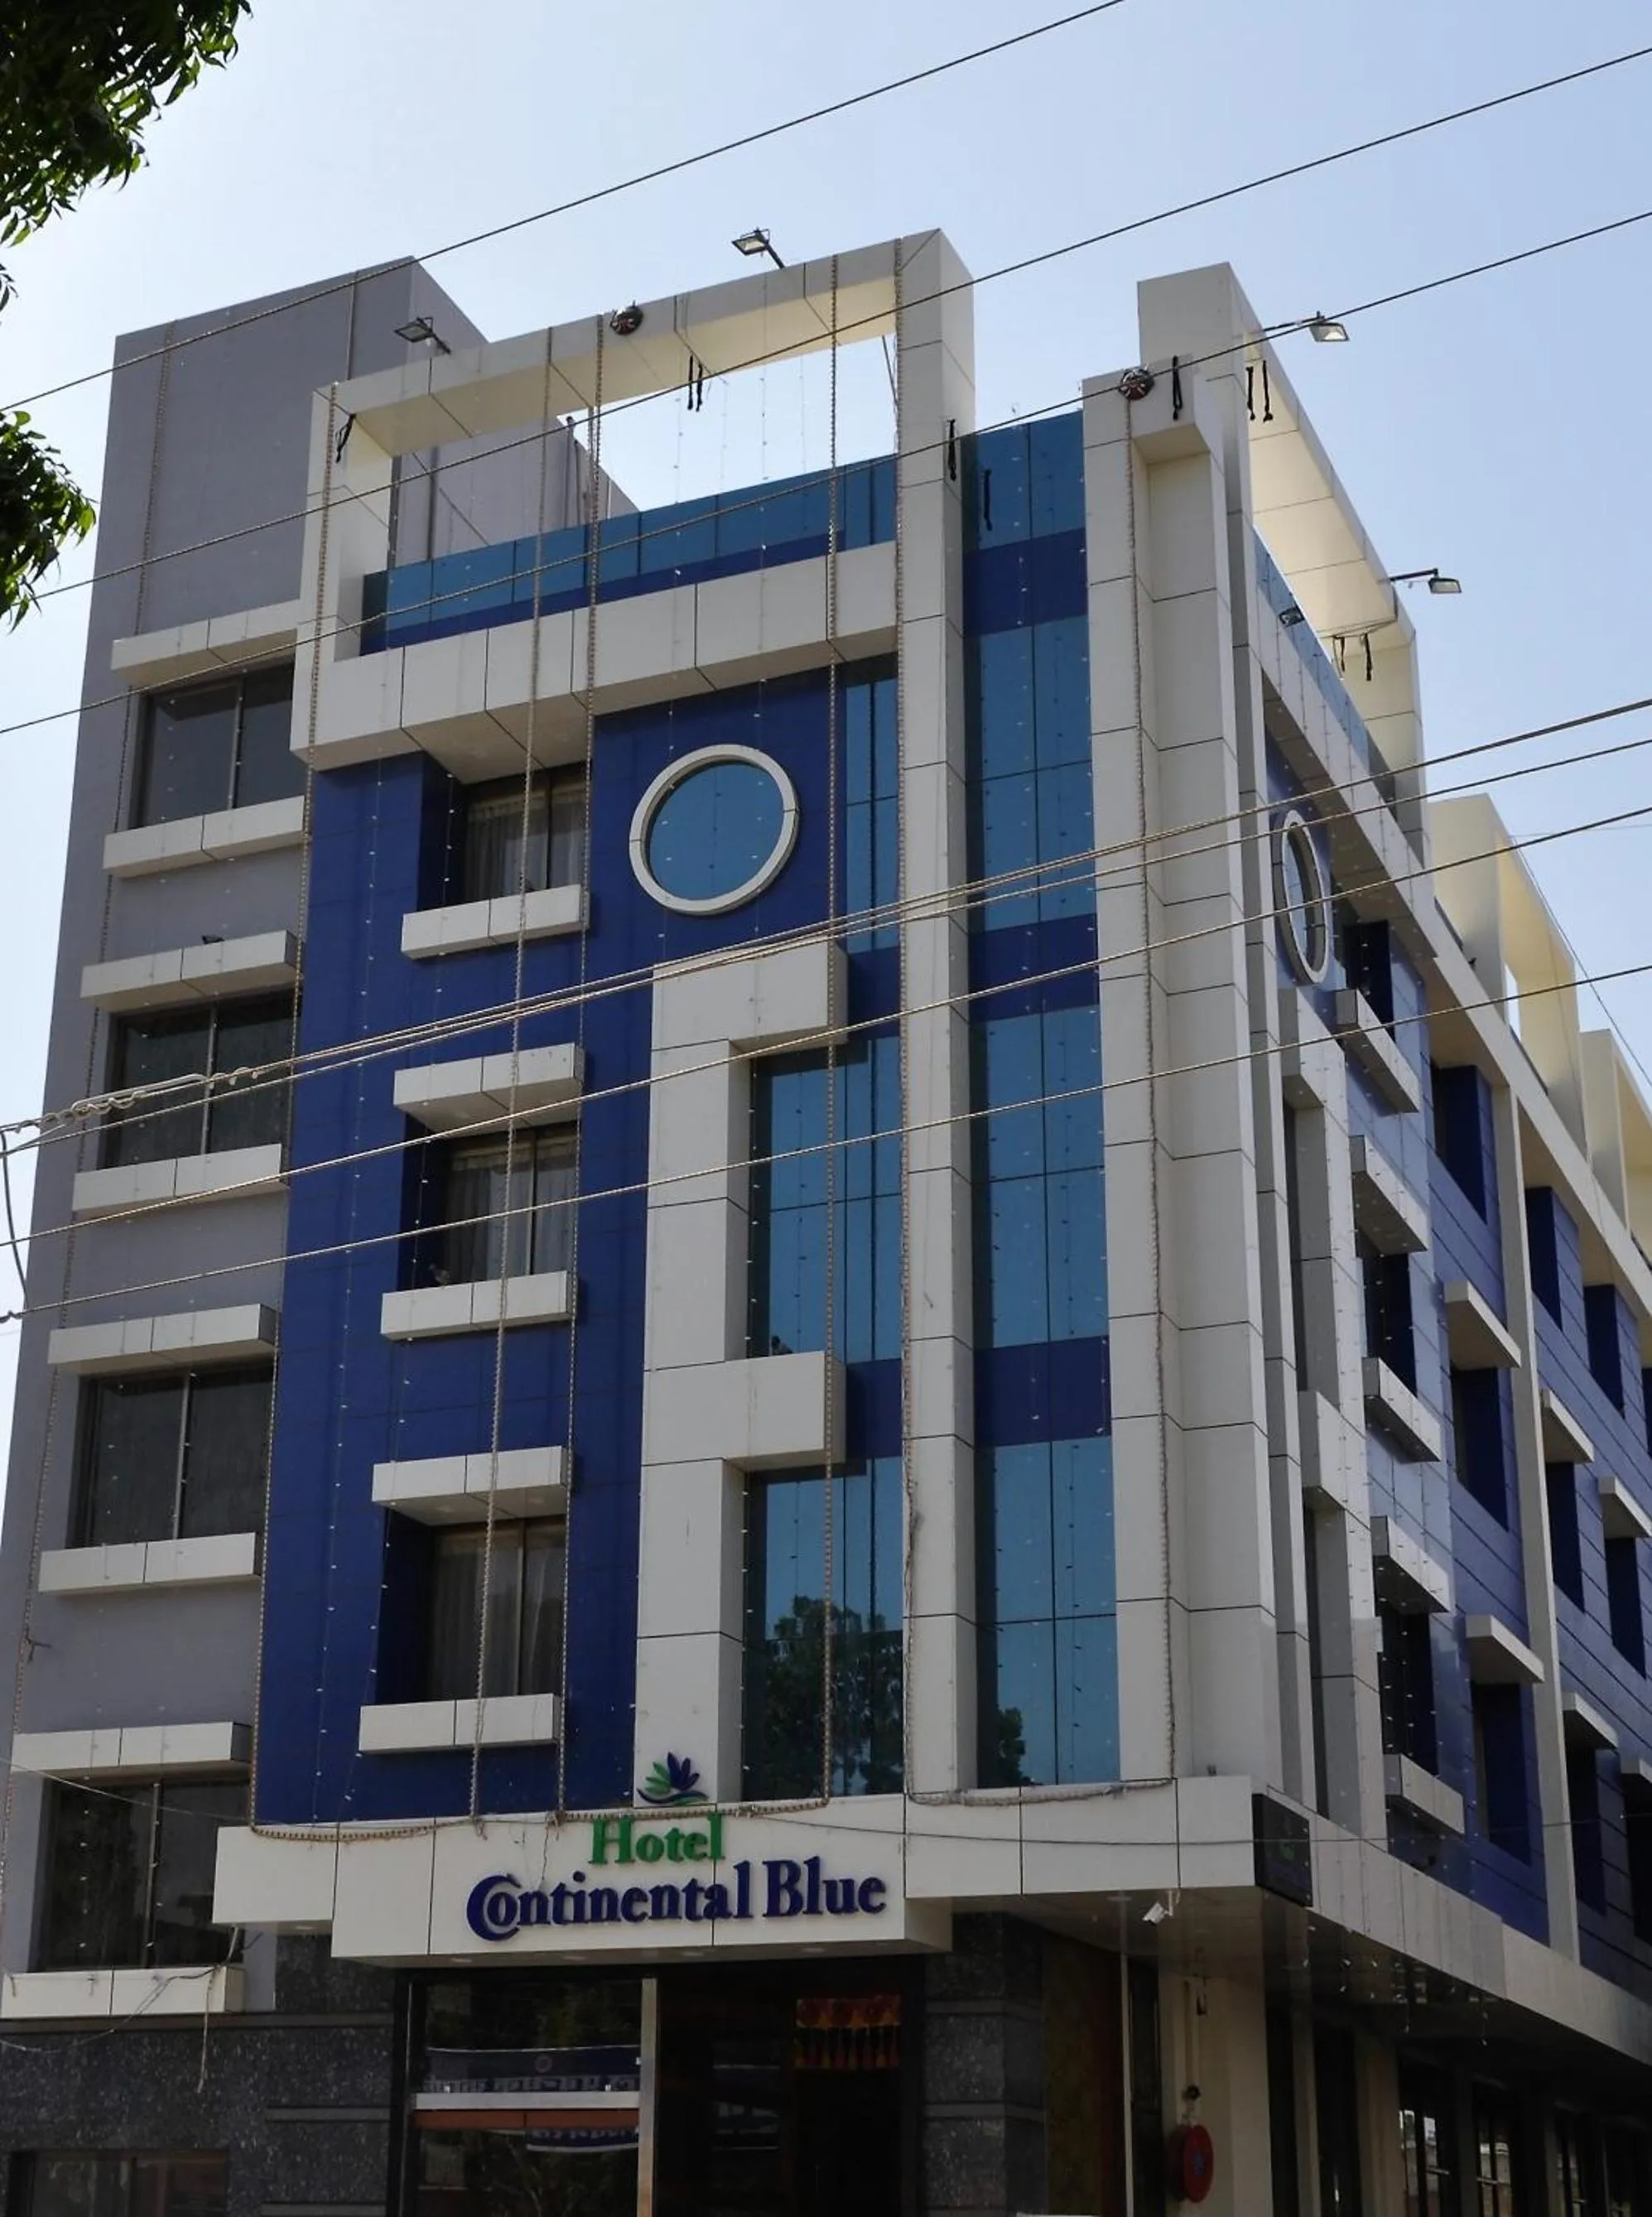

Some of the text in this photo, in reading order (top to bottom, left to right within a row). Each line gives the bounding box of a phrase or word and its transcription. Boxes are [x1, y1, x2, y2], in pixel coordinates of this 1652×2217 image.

[589, 1810, 725, 1865] Hotel
[467, 1855, 887, 1941] Continental Blue
